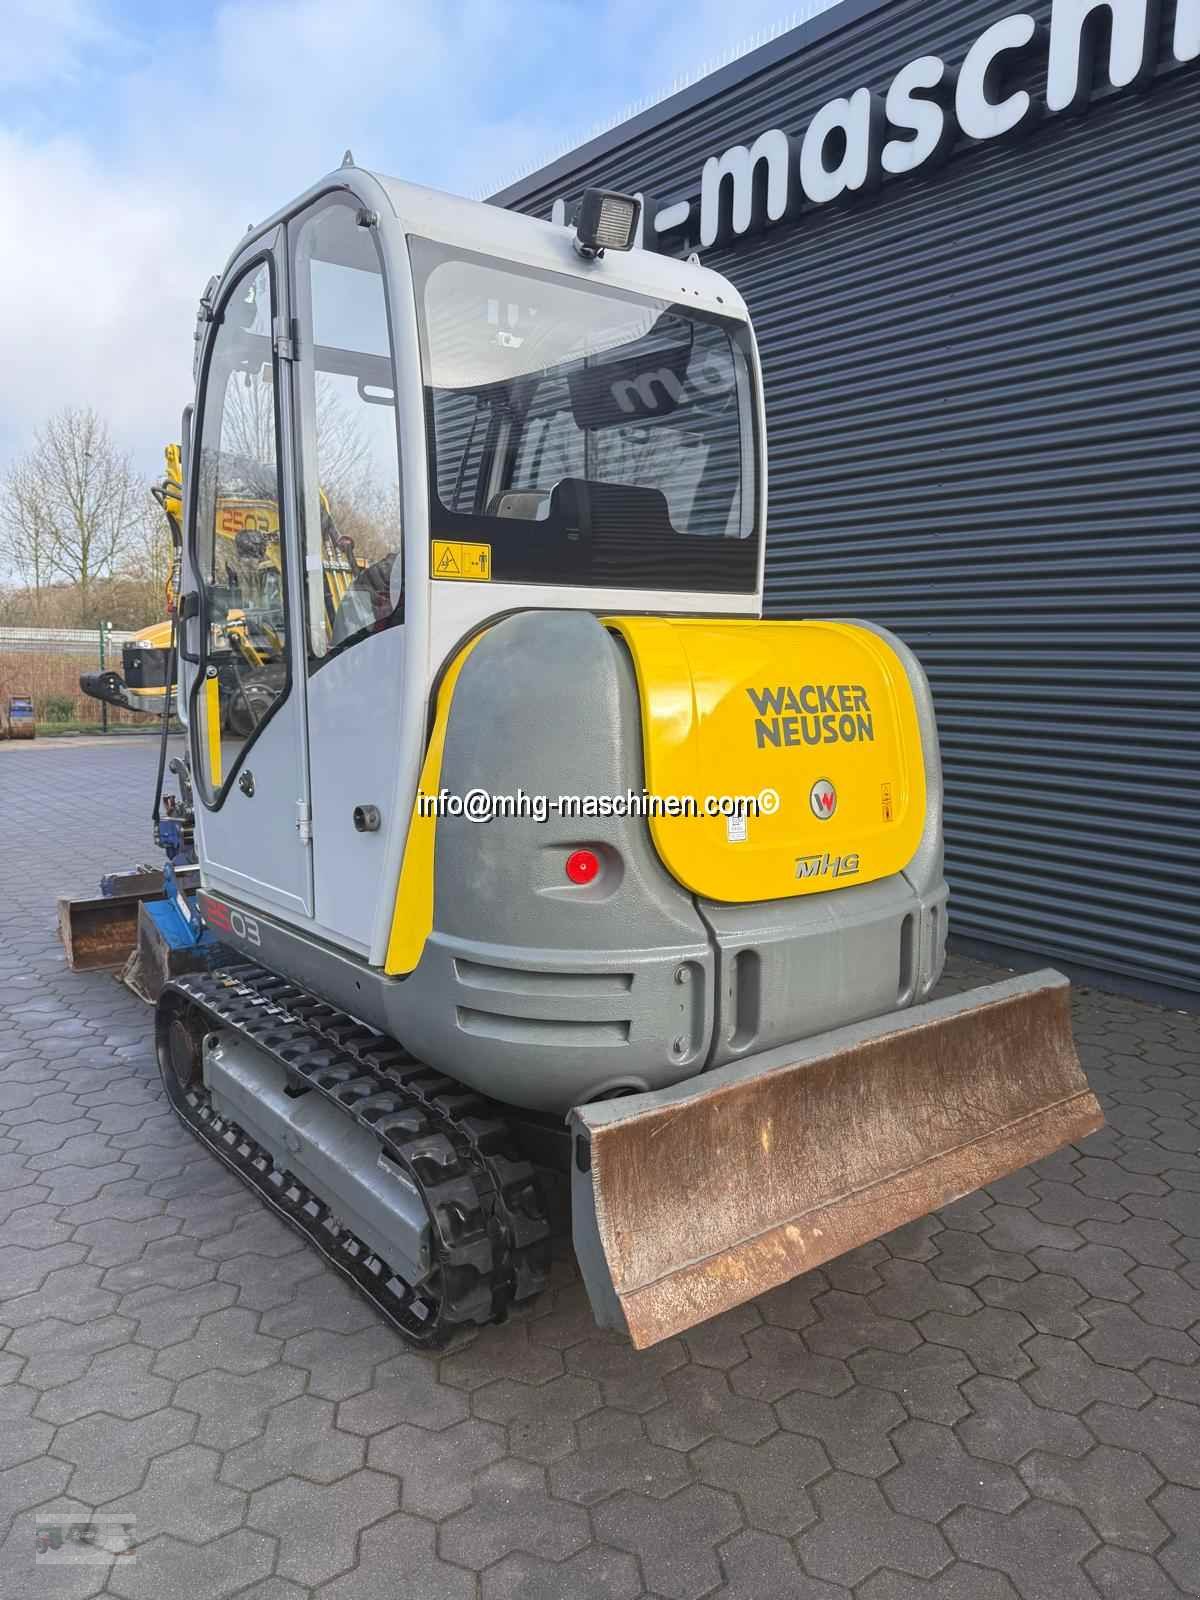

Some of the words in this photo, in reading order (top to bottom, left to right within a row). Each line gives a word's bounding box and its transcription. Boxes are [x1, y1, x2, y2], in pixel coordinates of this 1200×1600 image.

[746, 685, 872, 715] WACKER
[755, 713, 874, 748] NEUSON
[795, 853, 859, 879] MHG
